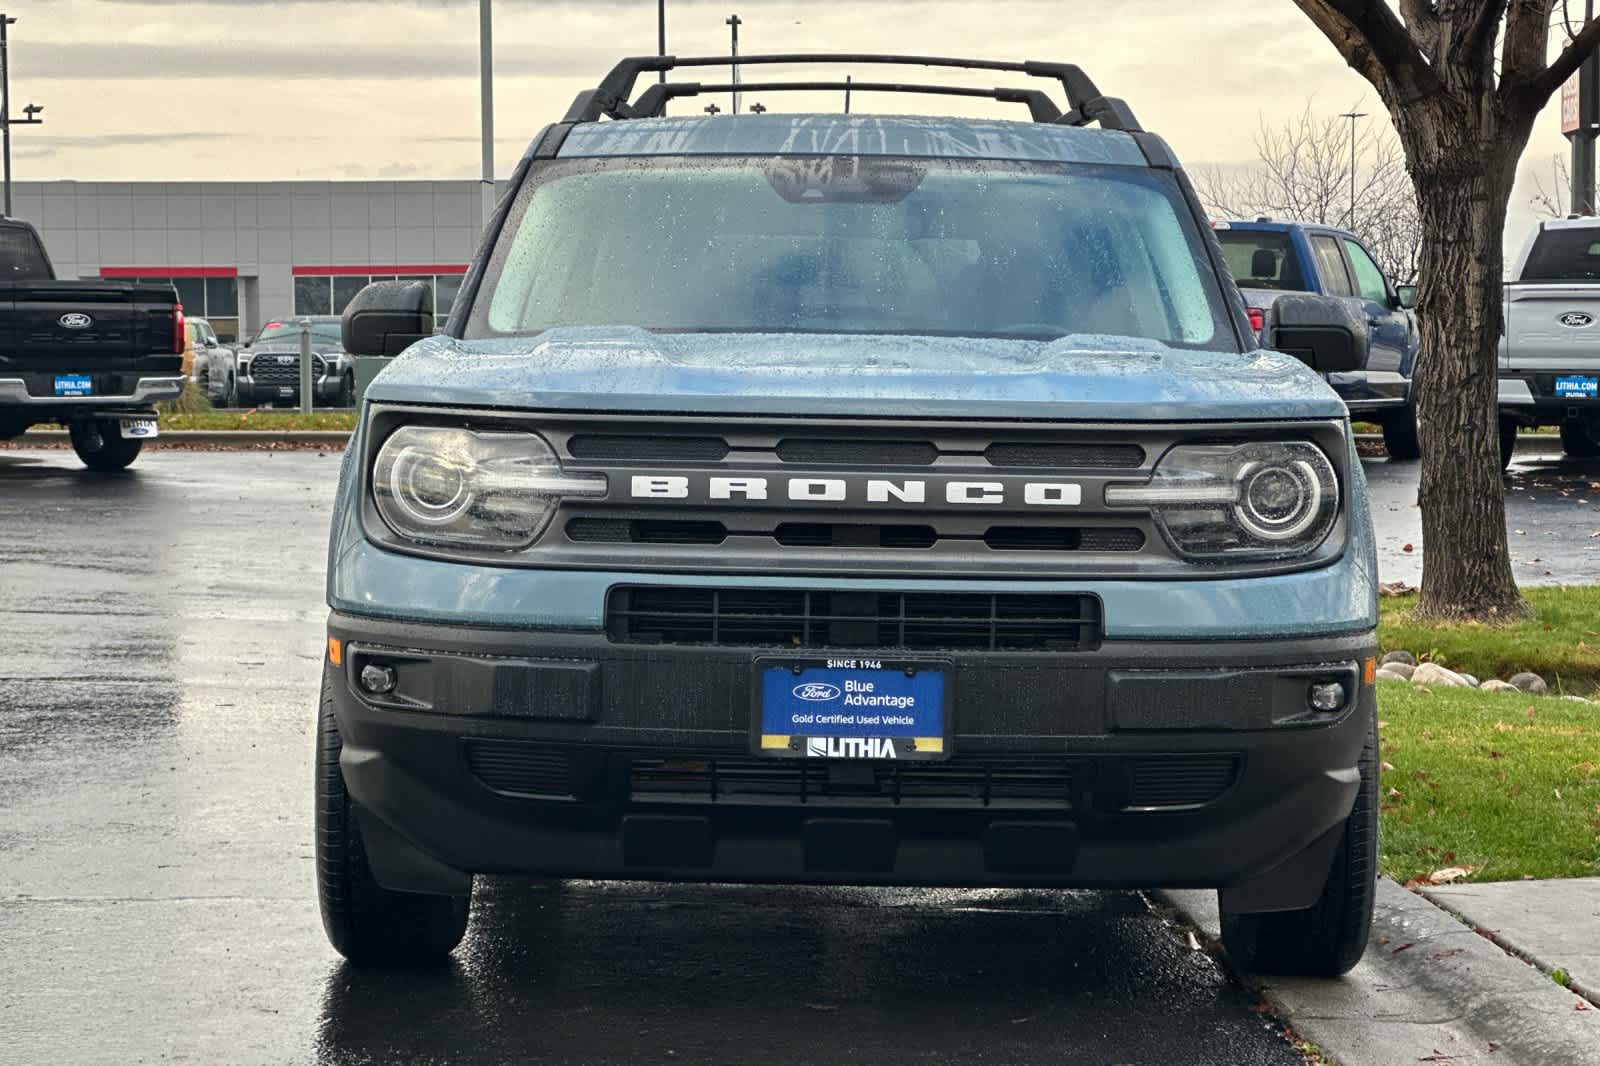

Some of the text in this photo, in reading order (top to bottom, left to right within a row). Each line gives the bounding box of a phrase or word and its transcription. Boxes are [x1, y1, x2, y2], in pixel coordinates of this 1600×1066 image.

[1564, 314, 1588, 325] Ford
[1555, 381, 1598, 391] LITHIA.COM
[631, 475, 1082, 506] BRONCO
[827, 659, 882, 669] SINCE 1946
[801, 685, 832, 699] Ford
[844, 680, 874, 692] Blue
[844, 694, 915, 708] Advantage
[792, 715, 915, 725] Gold Certified Used Vehicle
[827, 737, 897, 759] LITHIA
